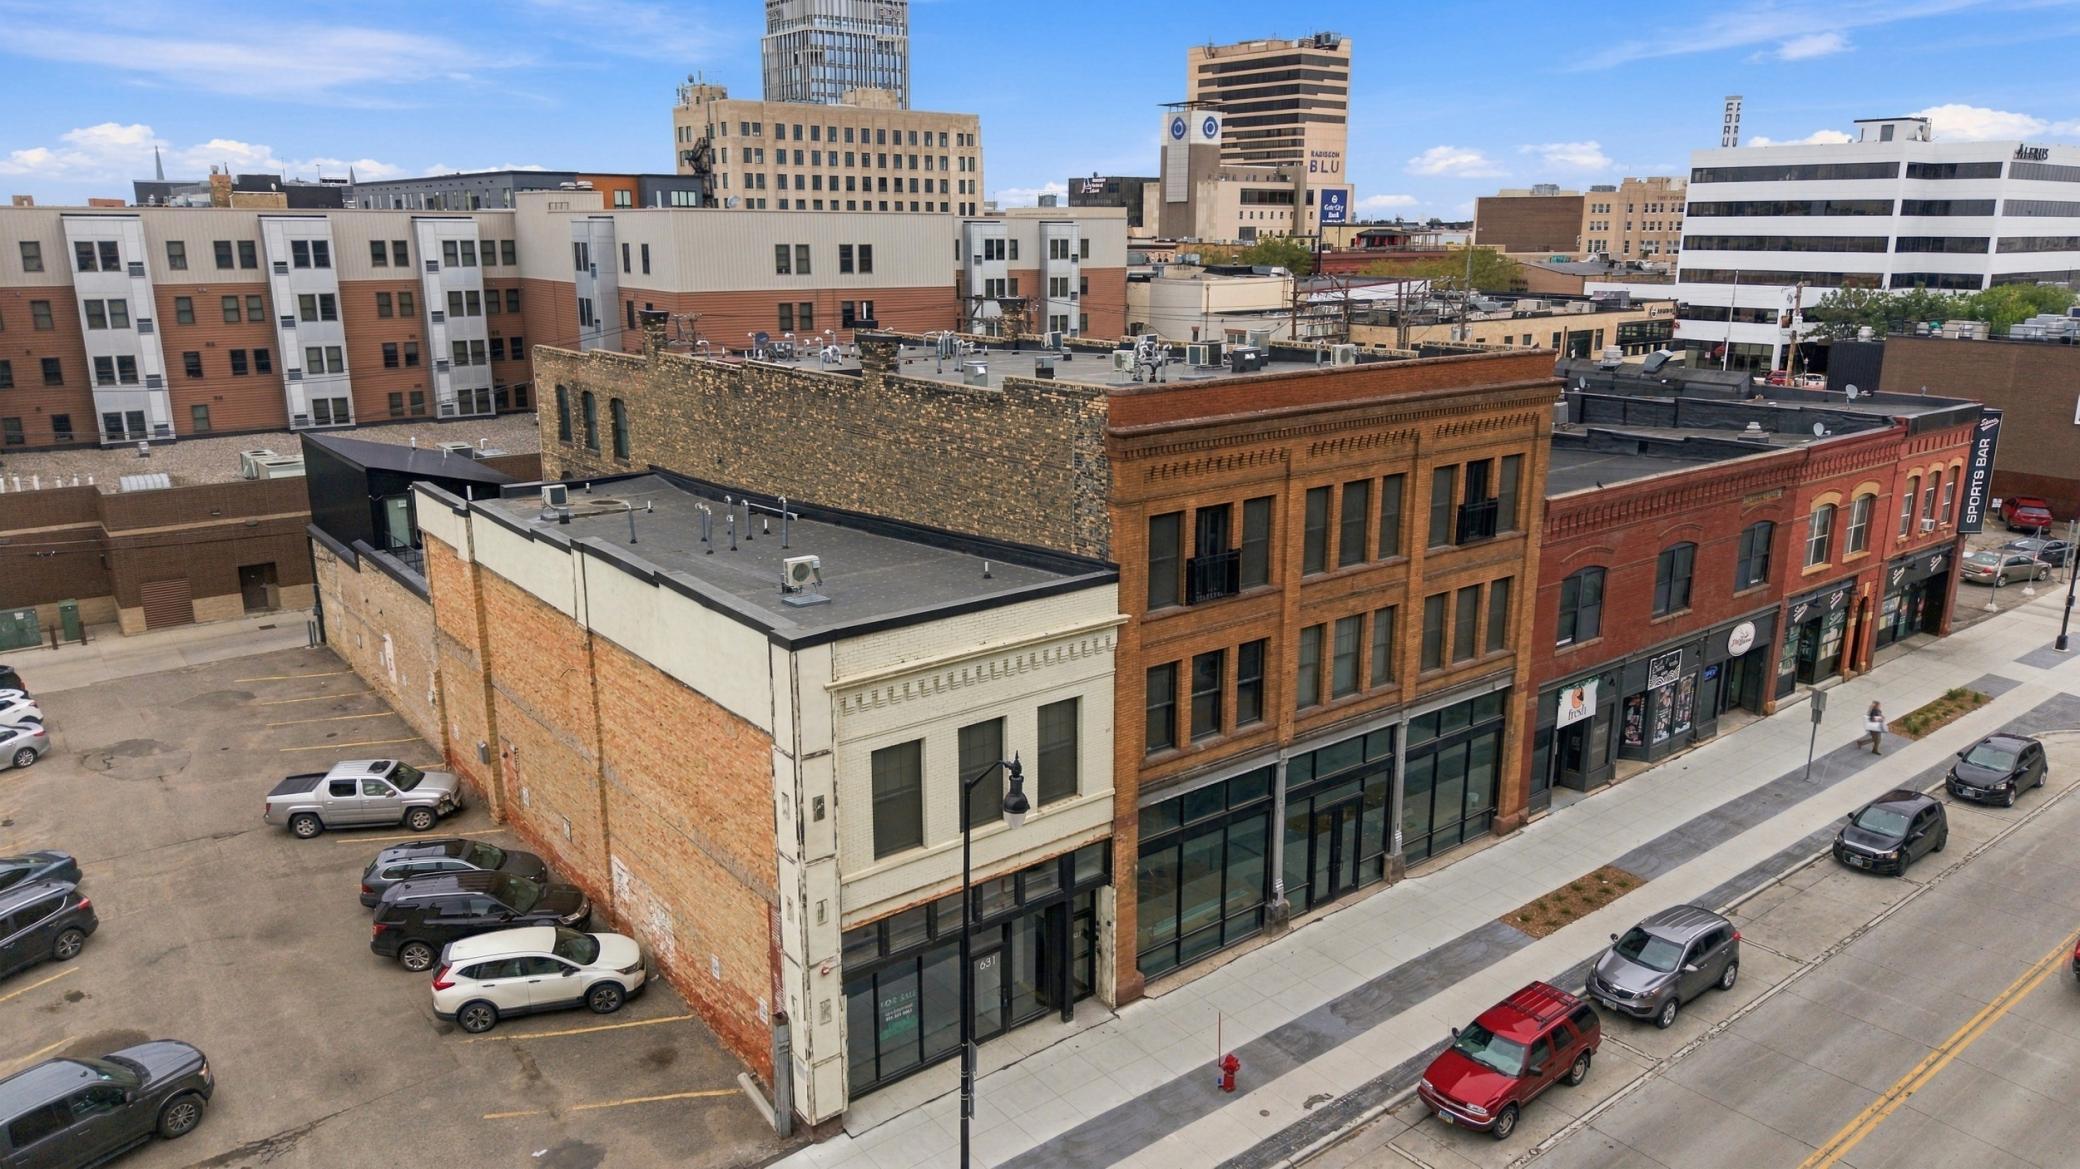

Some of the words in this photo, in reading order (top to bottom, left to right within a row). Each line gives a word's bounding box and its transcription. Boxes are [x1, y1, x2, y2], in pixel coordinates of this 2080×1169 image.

[1722, 102, 1733, 147] FORU
[1309, 160, 1340, 173] BLU
[1966, 470, 1985, 524] SPORTS
[1976, 438, 1991, 467] BAR
[980, 955, 996, 970] 631
